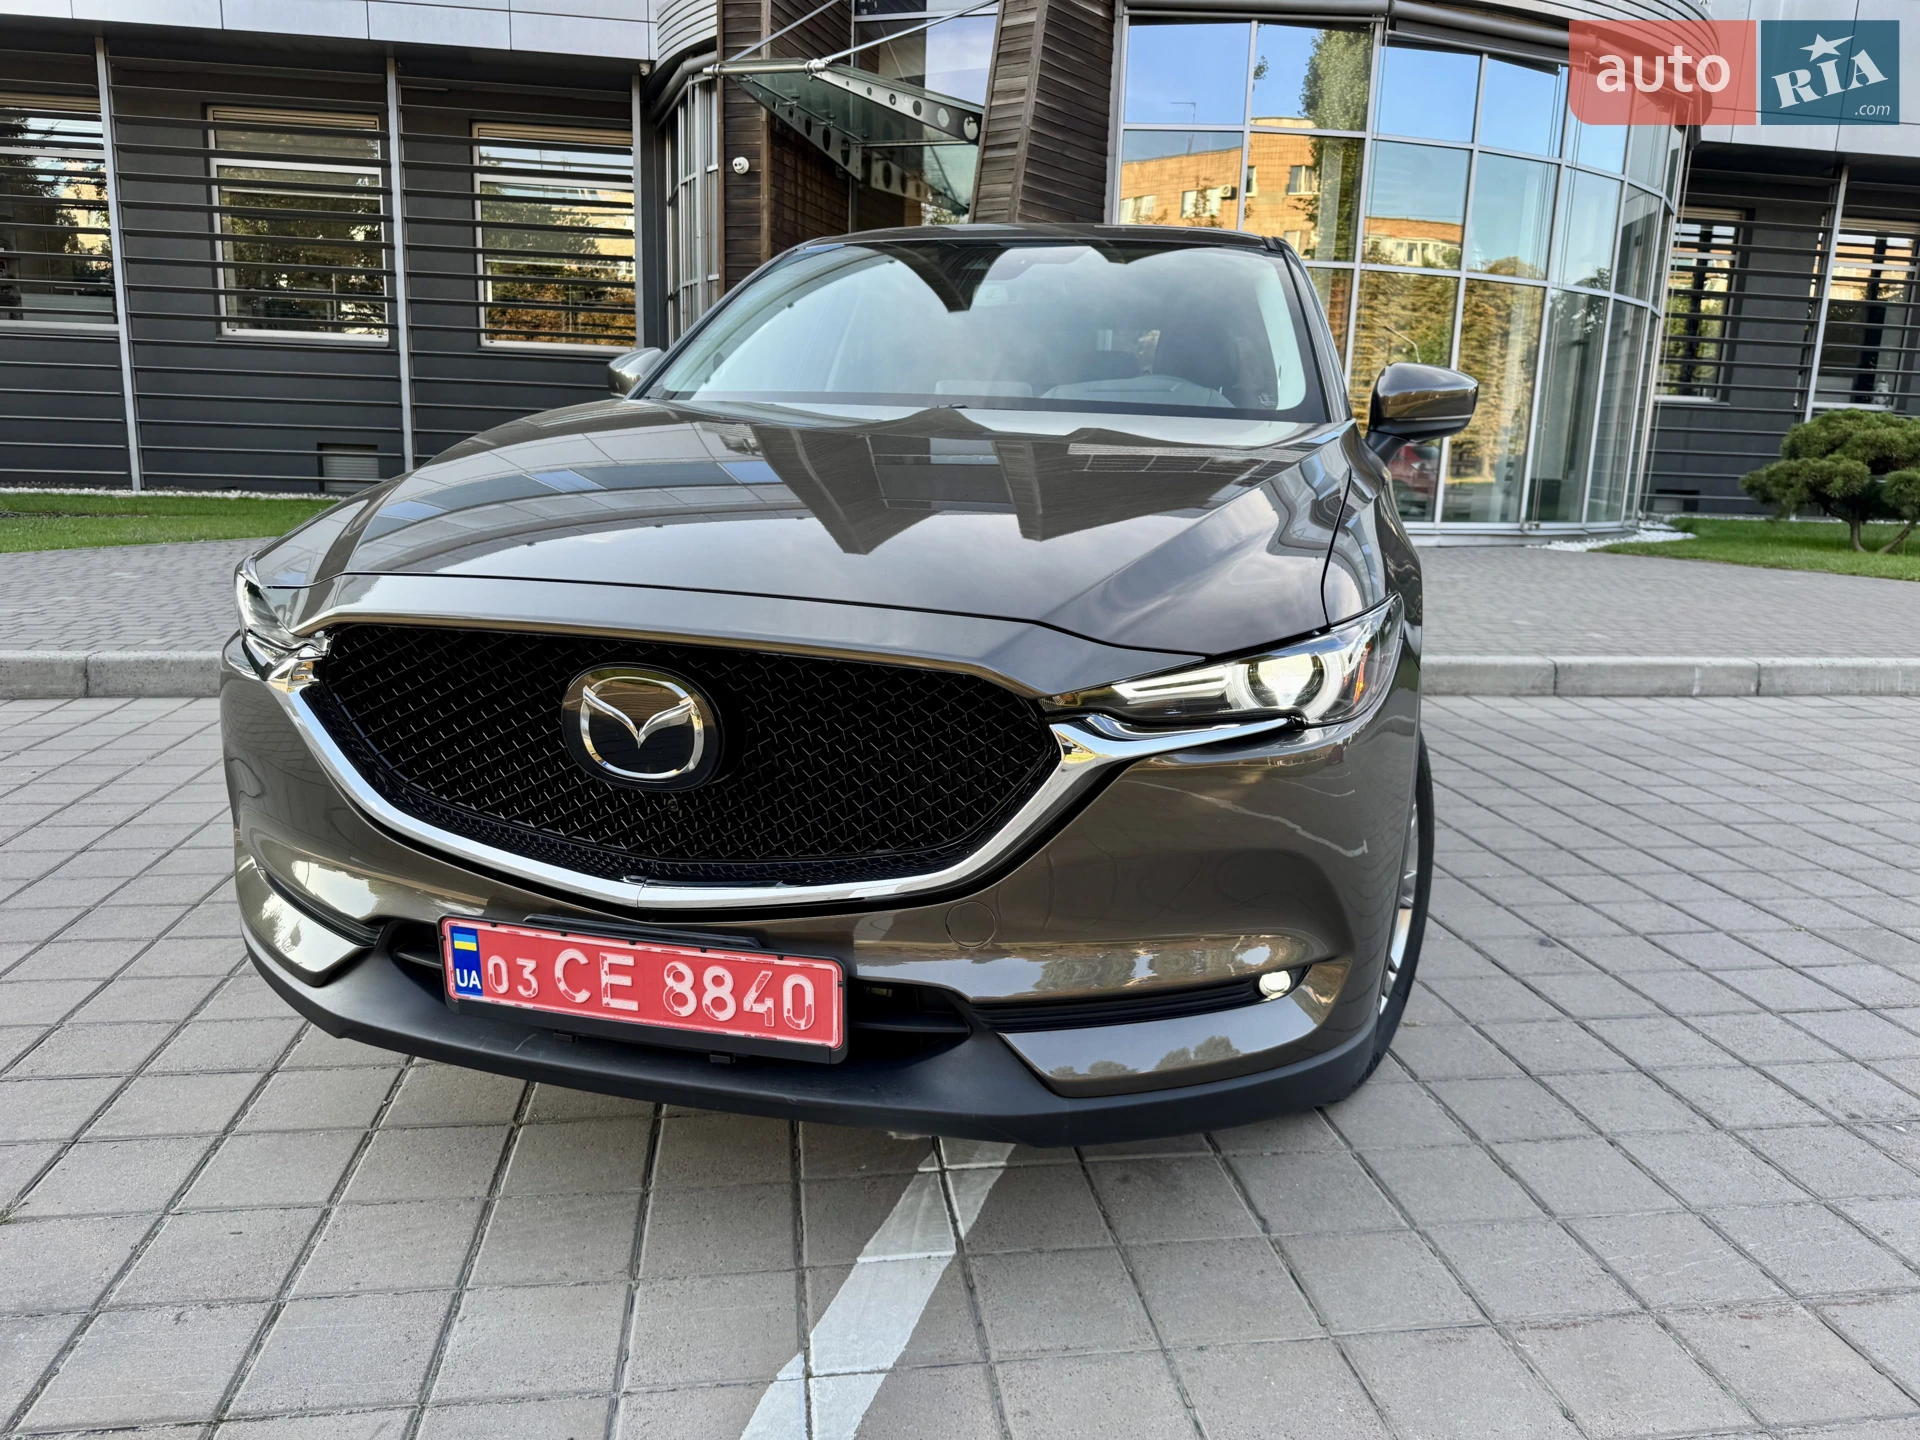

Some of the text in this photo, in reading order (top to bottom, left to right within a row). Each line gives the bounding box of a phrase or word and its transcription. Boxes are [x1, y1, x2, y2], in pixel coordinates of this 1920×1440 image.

[456, 968, 482, 990] UA
[487, 948, 815, 1031] 03 CE 8840
